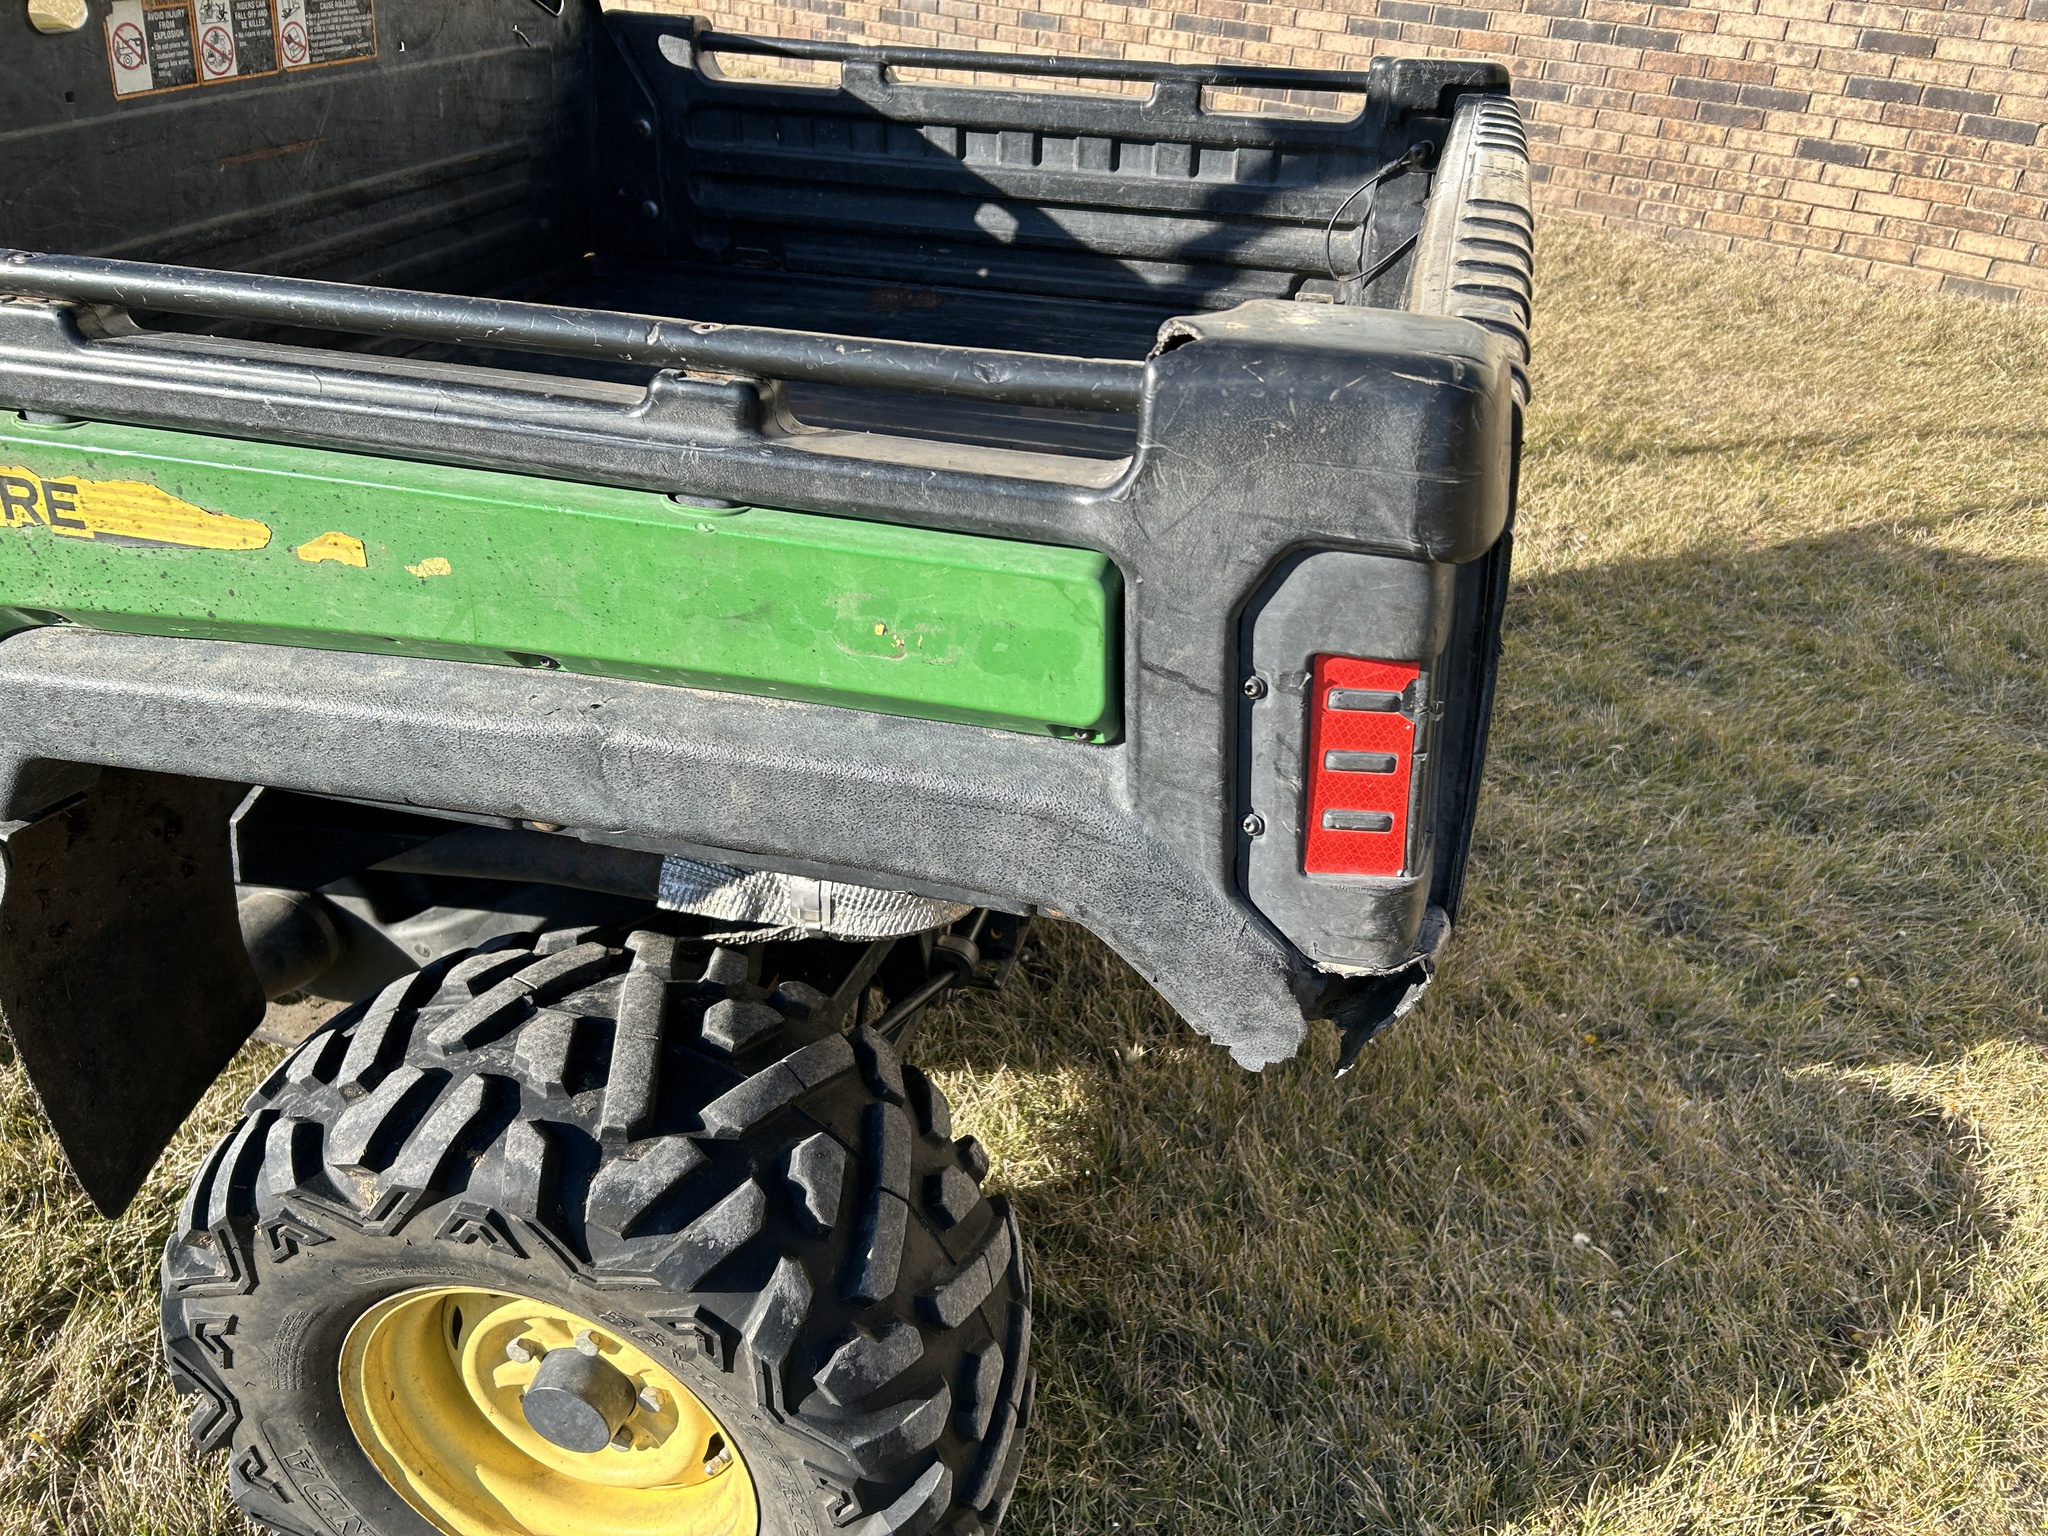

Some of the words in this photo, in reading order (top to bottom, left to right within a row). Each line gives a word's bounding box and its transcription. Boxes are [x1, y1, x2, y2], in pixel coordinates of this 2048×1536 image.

[236, 2, 254, 10] RIDERS
[255, 0, 266, 8] CAN
[320, 1, 334, 10] CAUSE
[147, 11, 165, 21] AVOID
[165, 9, 185, 18] INJURY
[234, 11, 247, 20] FALL
[247, 10, 258, 19] OFF
[258, 9, 268, 17] AND
[158, 20, 175, 29] FROM
[241, 20, 249, 29] BE
[248, 18, 266, 28] KILLED
[153, 29, 184, 40] EXPLOSION
